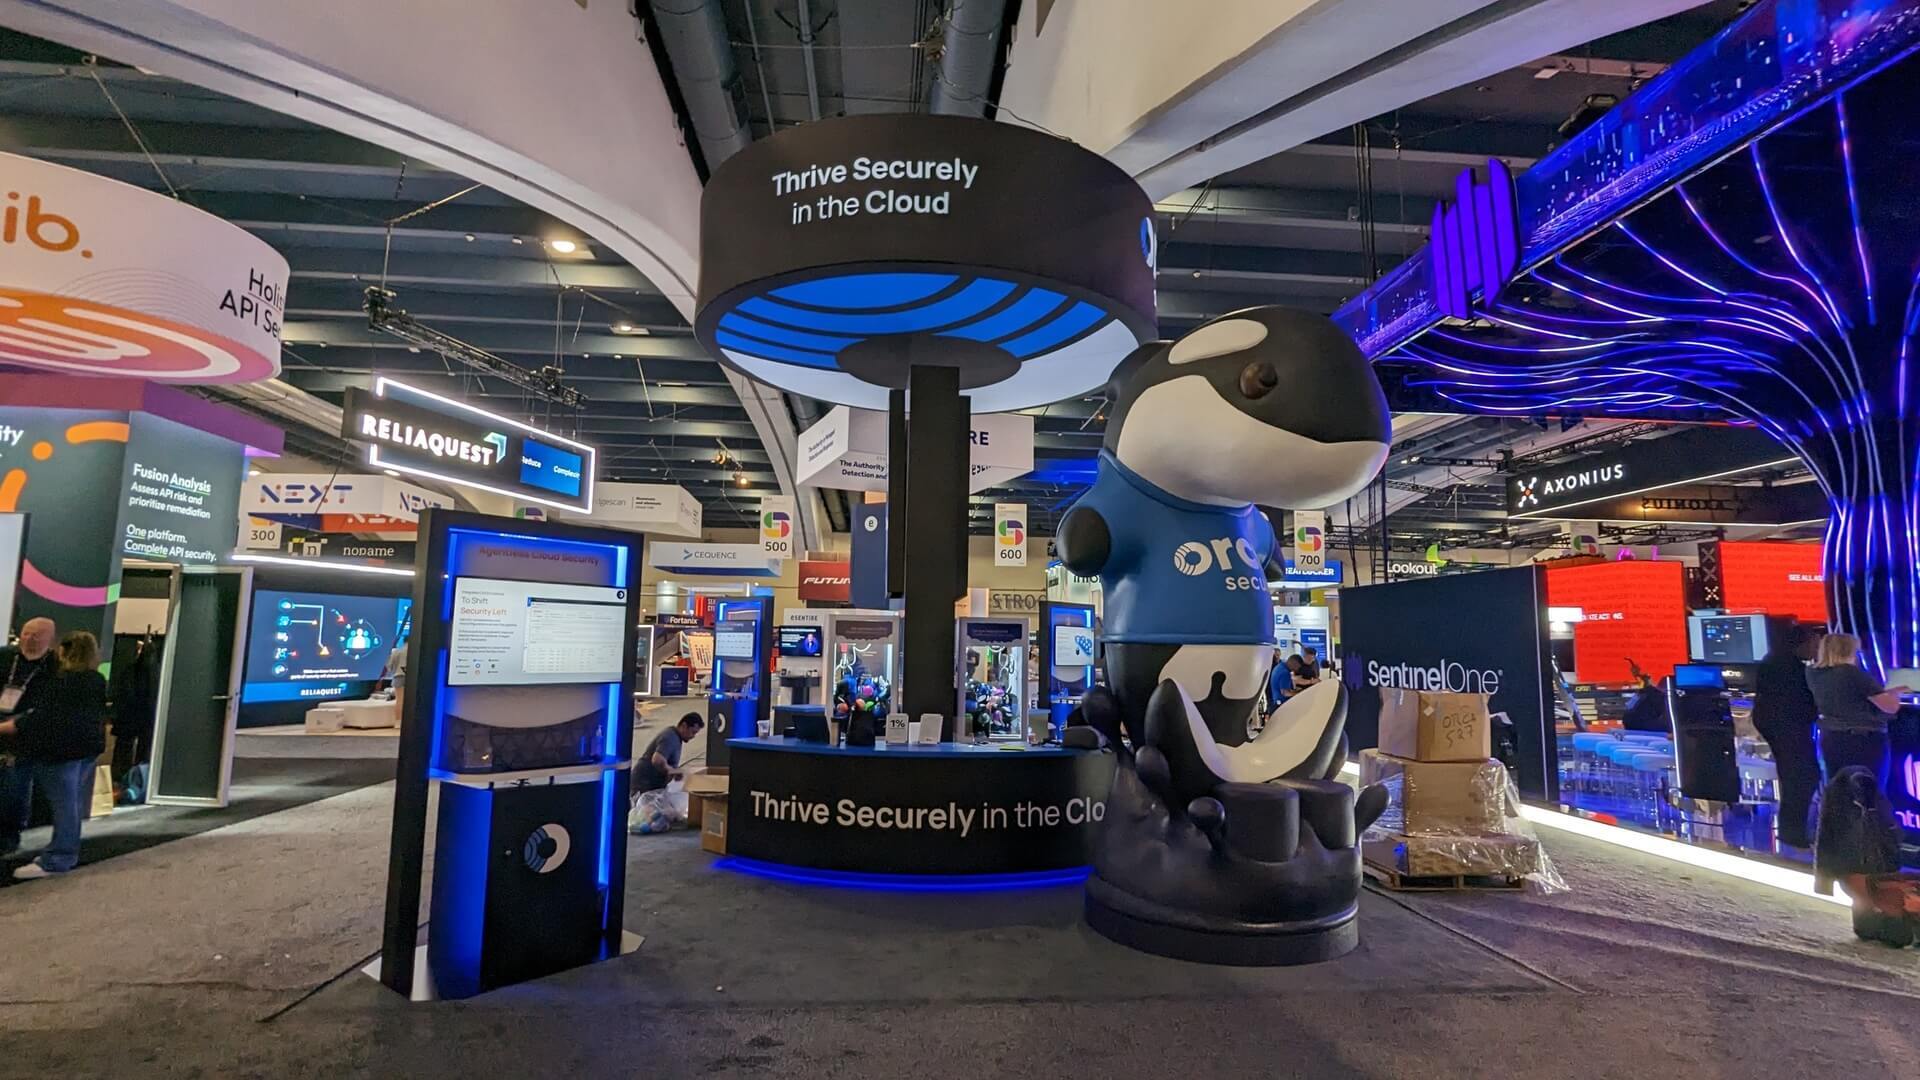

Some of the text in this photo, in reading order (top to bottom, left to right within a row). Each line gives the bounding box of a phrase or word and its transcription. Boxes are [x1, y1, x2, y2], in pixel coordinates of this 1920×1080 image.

[772, 156, 979, 197] Thrive Securely
[791, 190, 950, 226] in the Cloud
[219, 289, 259, 327] API
[361, 412, 494, 467] RELIAQUEST
[840, 459, 885, 472] The Authority
[132, 463, 212, 494] Fusion Analysis
[841, 469, 875, 479] Detection
[1543, 464, 1625, 495] AXONIUS
[130, 481, 203, 506] Assess API risk and
[259, 484, 353, 504] NEXT
[128, 495, 211, 519] prioritize remediation
[126, 523, 188, 544] One platform.
[250, 530, 276, 542] 300
[125, 539, 217, 563] Complete API security.
[764, 541, 788, 553] 500
[1000, 549, 1022, 560] 600
[694, 551, 738, 561] CEQUENCE
[1300, 554, 1321, 566] 700
[1386, 562, 1439, 575] Lookout
[460, 606, 491, 617] Security
[669, 616, 699, 626] Fortanix
[300, 687, 343, 697] RELIAQUEST
[889, 719, 906, 729] 1%
[750, 790, 830, 826] Thrive
[835, 798, 976, 838] Securely
[983, 801, 1008, 829] in
[1013, 800, 1061, 828] the
